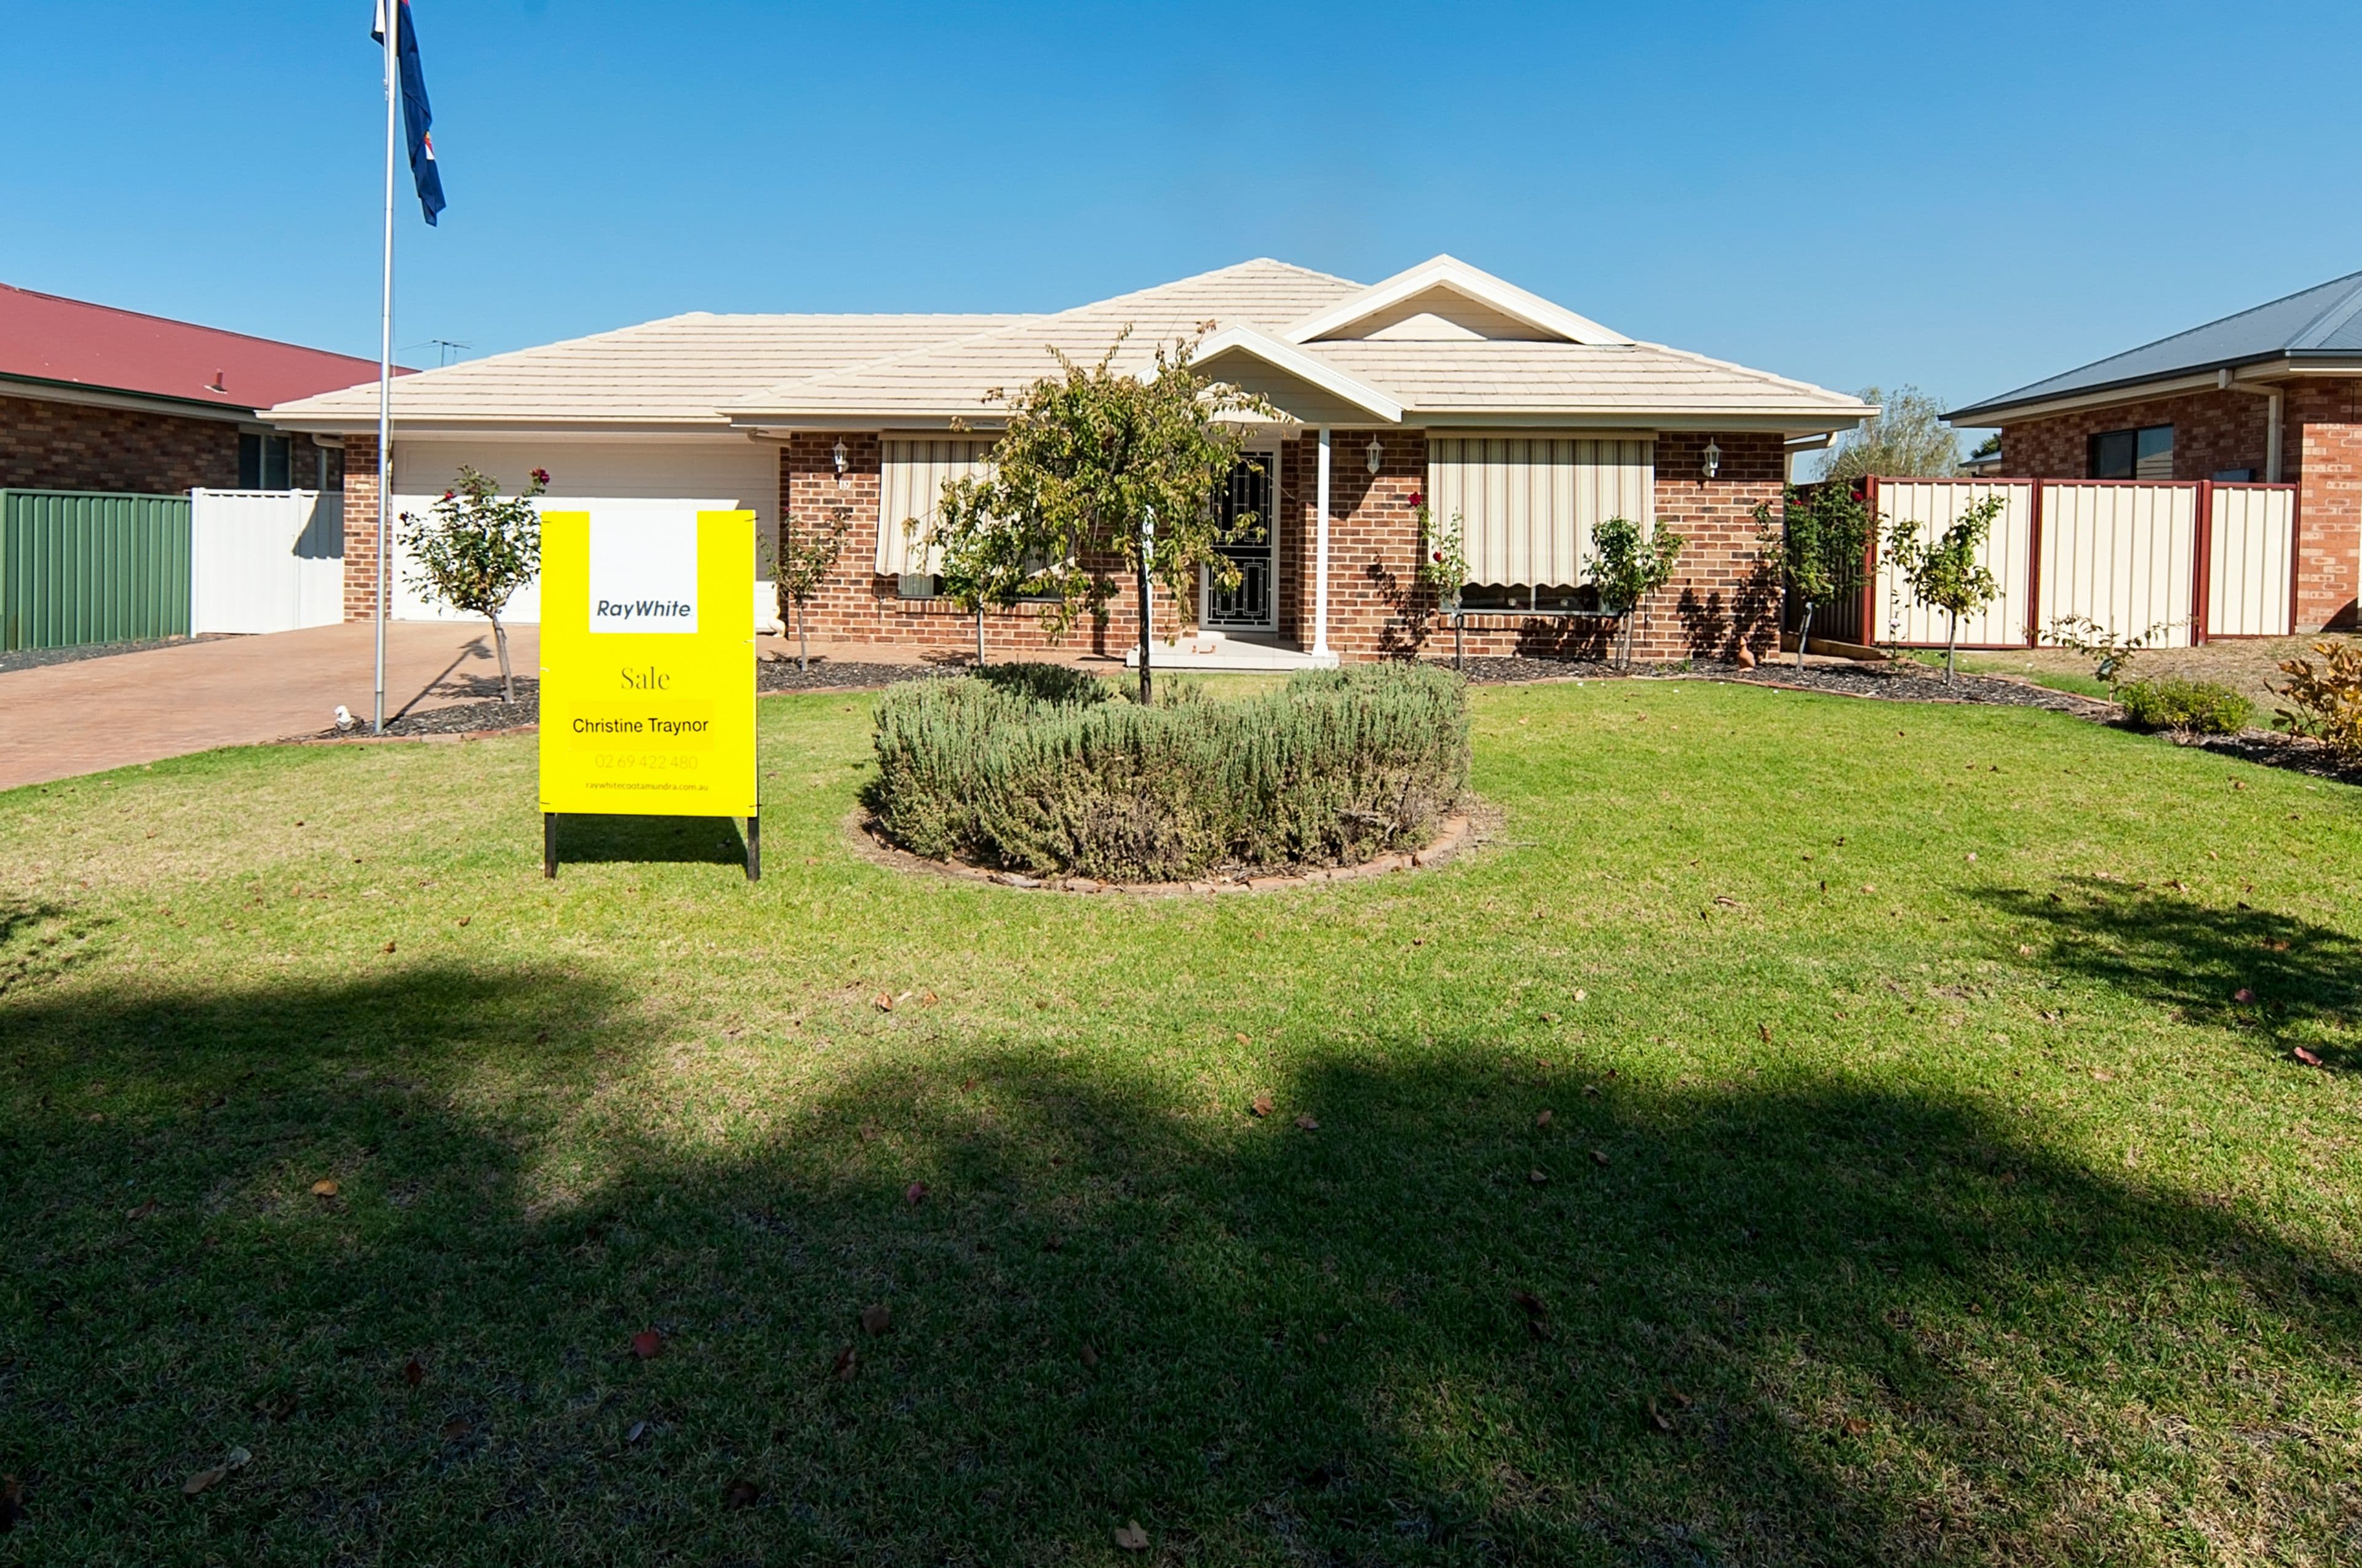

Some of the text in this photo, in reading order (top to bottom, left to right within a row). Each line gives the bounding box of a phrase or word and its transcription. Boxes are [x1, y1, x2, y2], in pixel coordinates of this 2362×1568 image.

[597, 600, 691, 620] RayWhite
[621, 666, 670, 690] Sale
[573, 717, 709, 736] Christine Traynor
[595, 754, 699, 770] 02 69 422 480
[586, 781, 709, 792] raywhitecootamundra.com.au
